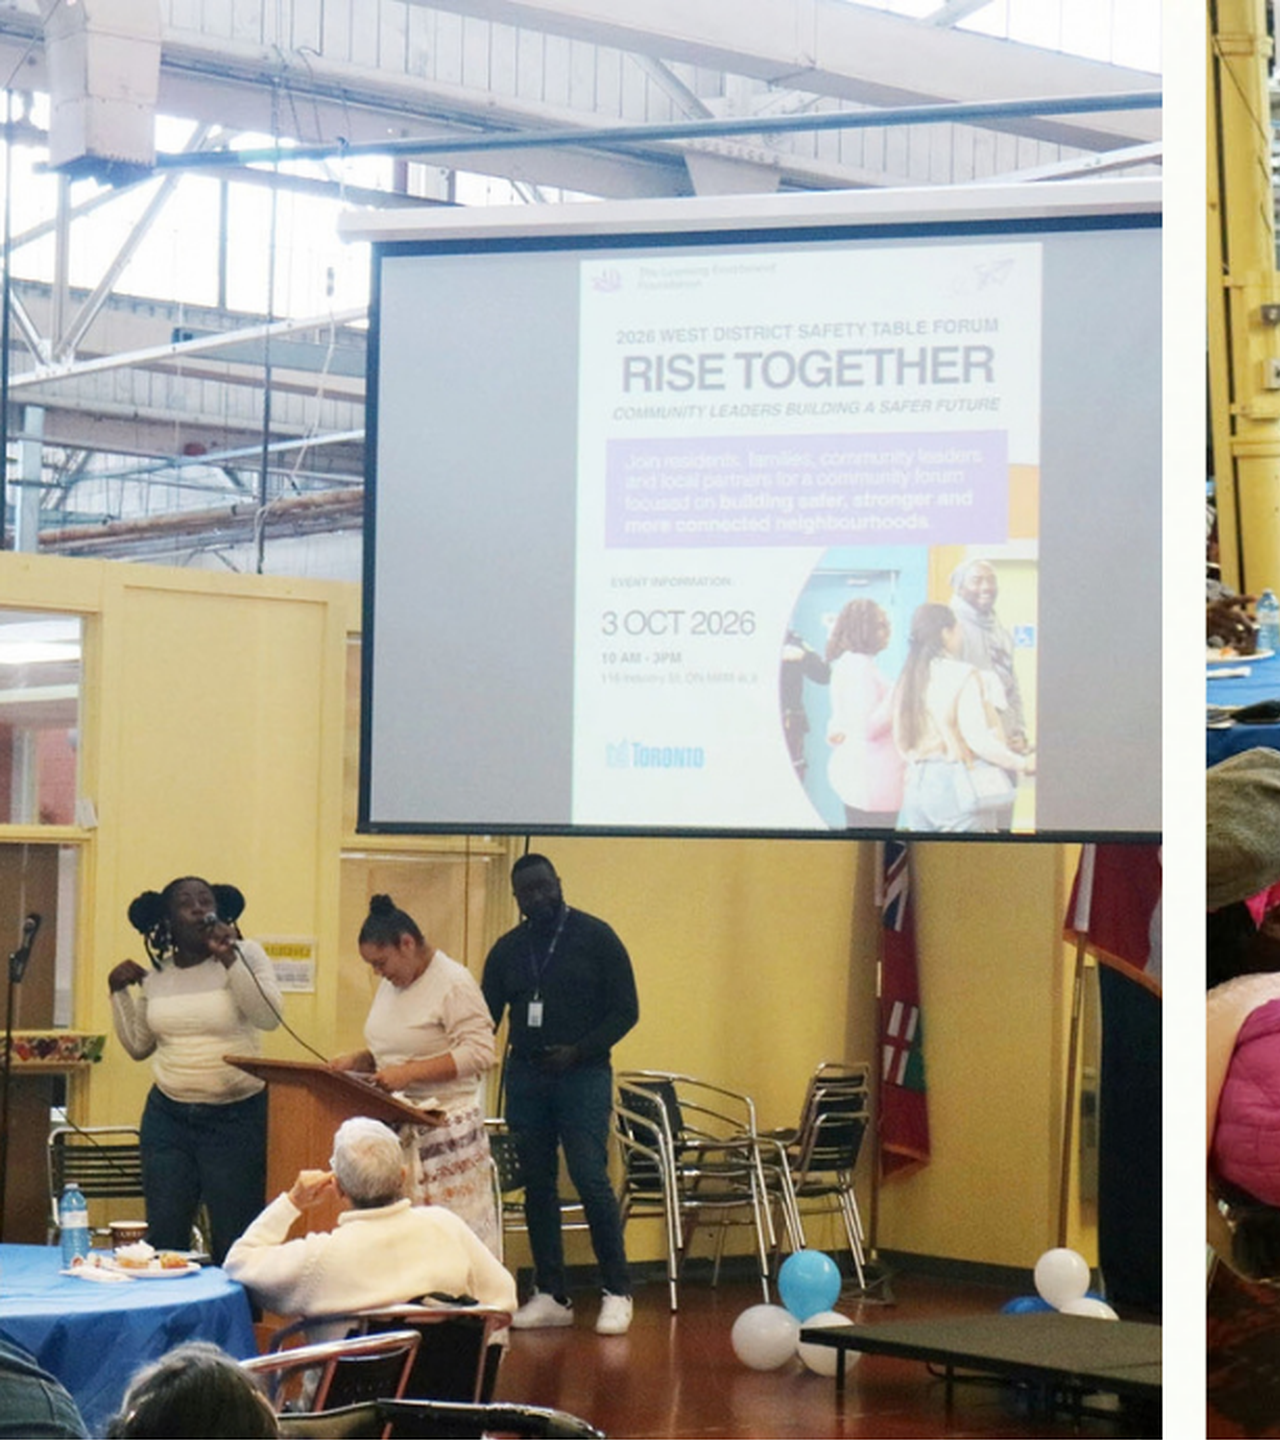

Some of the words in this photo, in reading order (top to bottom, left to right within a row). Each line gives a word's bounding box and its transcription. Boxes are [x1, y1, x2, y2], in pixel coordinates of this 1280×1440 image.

[615, 328, 656, 344] 2026
[658, 326, 709, 343] WEST
[713, 324, 794, 341] DISTRICT
[797, 321, 867, 339] SAFETY
[871, 319, 928, 337] TABLE
[931, 317, 999, 334] FORUM
[622, 352, 726, 393] RISE
[732, 344, 996, 391] TOGETHER
[612, 403, 706, 421] COMMUNITY
[708, 402, 783, 418] LEADERS
[785, 400, 860, 417] BUILDING
[860, 400, 875, 415] A
[879, 398, 932, 414] SAFER
[935, 396, 1002, 413] FUTURE
[819, 450, 912, 470] community
[625, 473, 657, 490] and
[816, 469, 909, 491] community
[625, 494, 690, 512] focused
[719, 492, 794, 514] building
[852, 491, 935, 513] stronger
[937, 490, 974, 508] and
[625, 518, 672, 534] more
[675, 514, 770, 533] connected
[609, 575, 648, 589] EVENT
[600, 609, 619, 636] 3
[622, 609, 687, 636] OCT
[689, 609, 757, 636] 2026
[619, 651, 642, 665] AM
[631, 741, 706, 768] TORONTO
